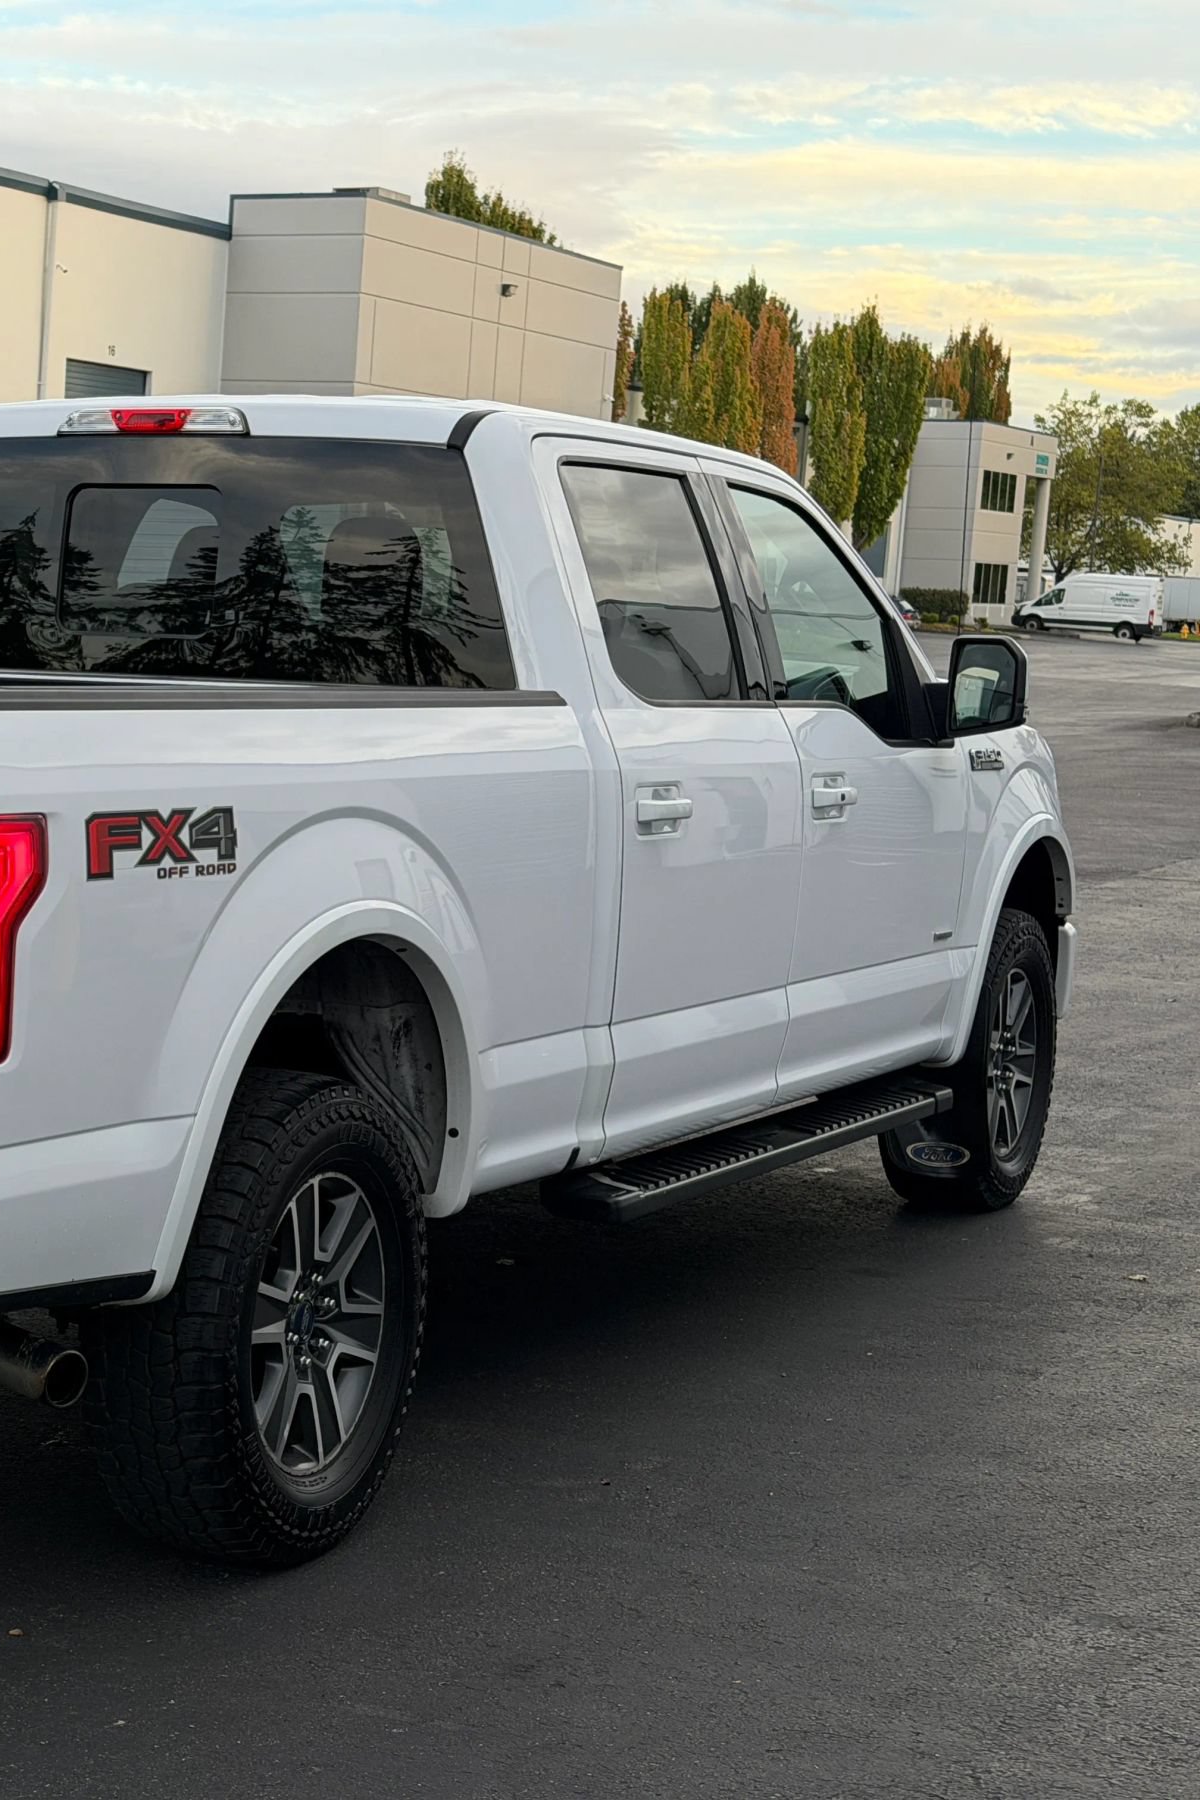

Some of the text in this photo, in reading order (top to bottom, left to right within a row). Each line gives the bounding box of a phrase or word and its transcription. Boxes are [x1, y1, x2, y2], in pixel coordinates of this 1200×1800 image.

[85, 805, 238, 882] FX4
[156, 863, 237, 880] OFF ROAD
